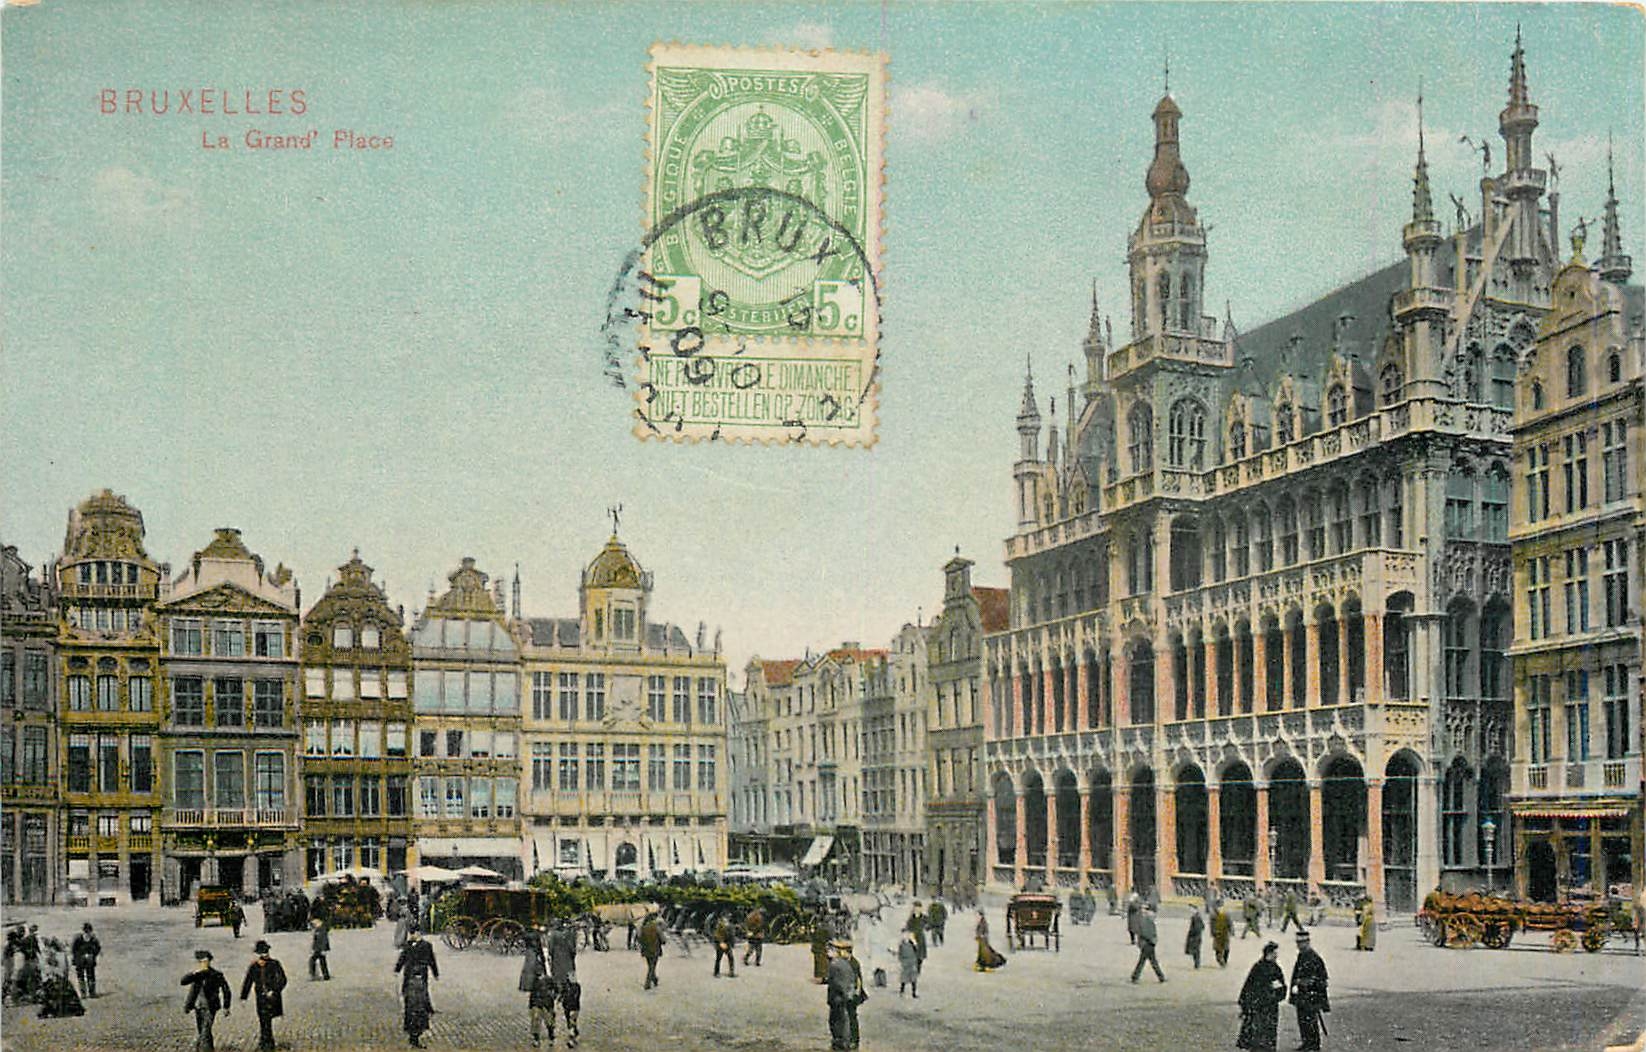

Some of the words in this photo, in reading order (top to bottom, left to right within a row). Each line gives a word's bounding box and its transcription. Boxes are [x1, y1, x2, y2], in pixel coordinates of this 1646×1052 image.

[727, 77, 799, 94] POSTES
[655, 359, 676, 387] NE
[758, 363, 775, 390] LE
[655, 390, 689, 416] NIET
[693, 391, 769, 420] BESTELLEN
[774, 394, 792, 420] OP
